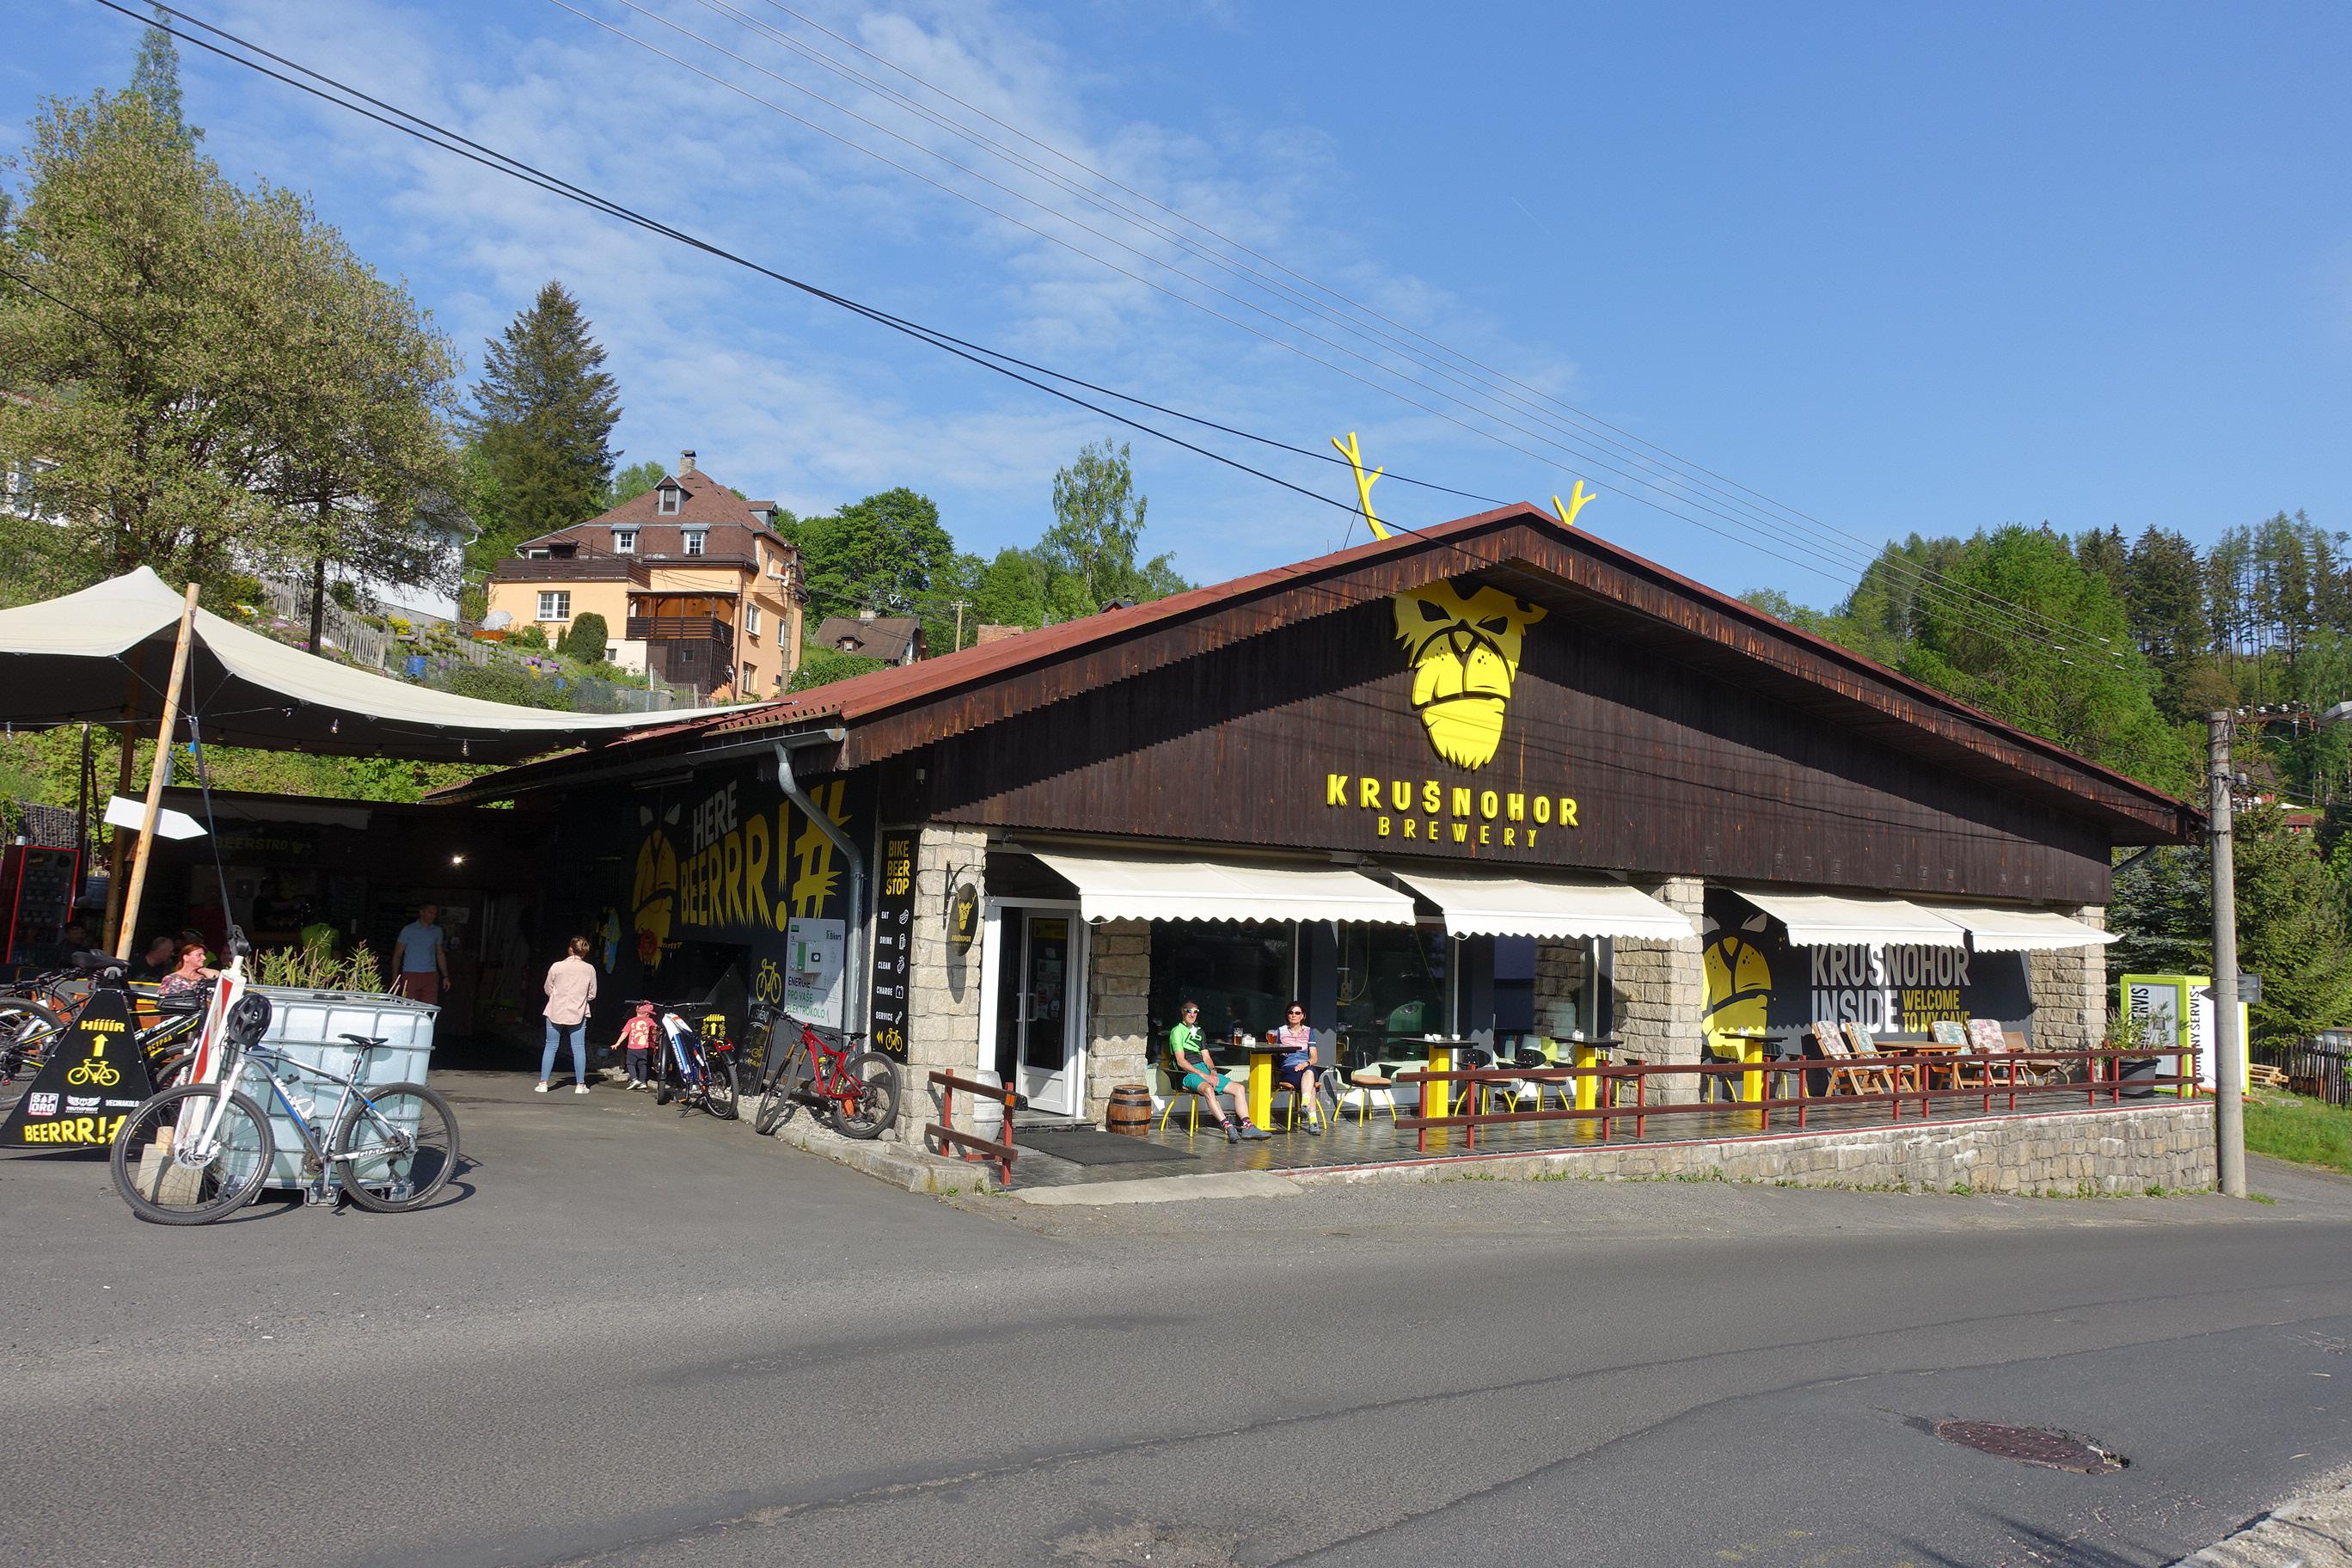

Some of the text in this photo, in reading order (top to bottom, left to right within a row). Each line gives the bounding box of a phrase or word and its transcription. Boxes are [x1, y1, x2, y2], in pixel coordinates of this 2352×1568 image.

[1326, 774, 1578, 826] KRUŠNOHOR
[693, 780, 738, 854] HERE
[1378, 817, 1537, 848] BREWERY
[888, 840, 910, 858] BIKE
[887, 860, 910, 877] BEER
[885, 878, 910, 895] STOP
[881, 911, 890, 920] EAT
[879, 936, 892, 945] DRINK
[878, 961, 891, 970] CLEAN
[788, 977, 811, 988] ENERGIE
[877, 986, 893, 995] CHARGE
[787, 990, 813, 1002] PRO VAŠE
[1902, 989, 1960, 1011] WELCOME
[787, 1004, 825, 1019] ELEKTROKOLO
[876, 1011, 893, 1021] SERVICE
[1811, 989, 1899, 1033] INSIDE
[2190, 990, 2200, 1031] SERVIS
[1902, 1012, 1919, 1033] TO
